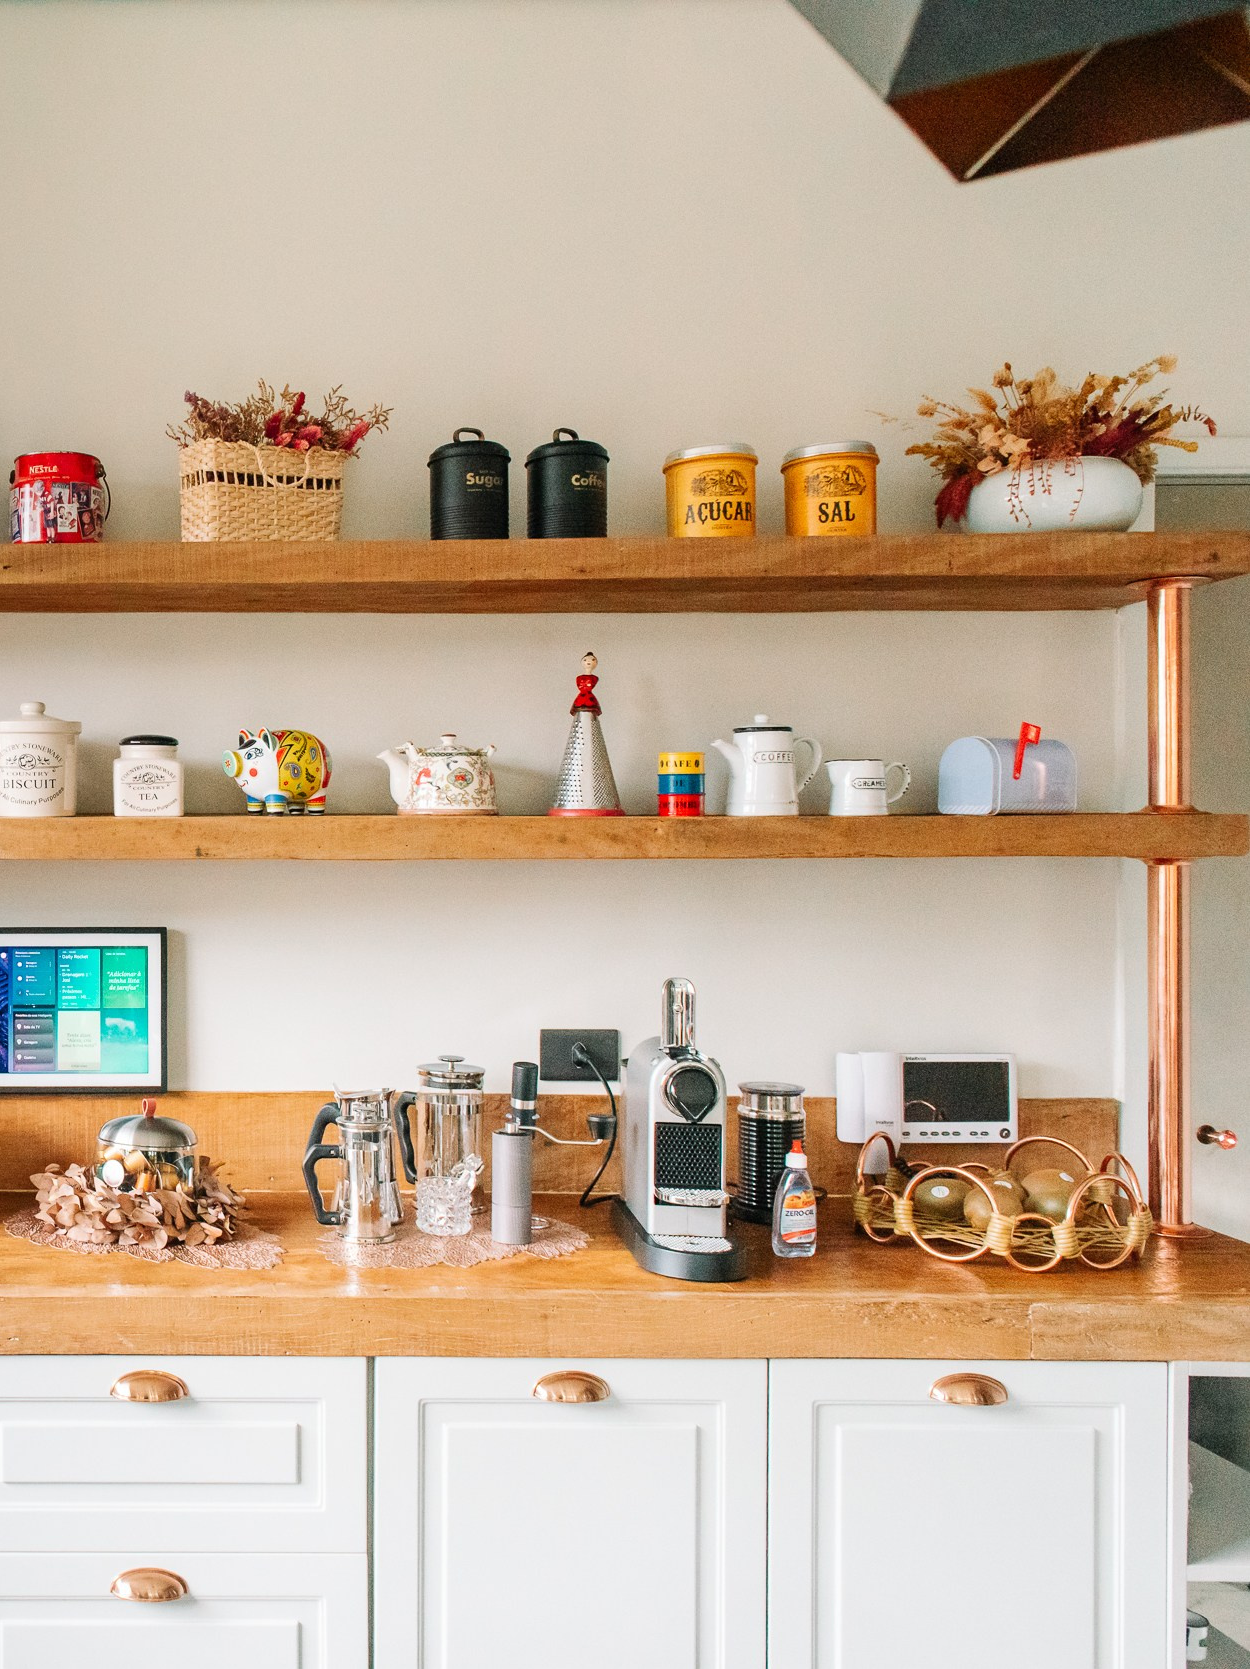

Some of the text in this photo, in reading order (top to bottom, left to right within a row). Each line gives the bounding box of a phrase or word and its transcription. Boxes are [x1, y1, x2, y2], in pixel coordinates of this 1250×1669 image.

[466, 472, 503, 488] Suga
[571, 473, 604, 487] Coffe
[684, 498, 753, 526] AÇÚCAR
[818, 500, 856, 523] SAL
[22, 743, 64, 763] STONEWARE
[121, 765, 144, 781] COUNTRY
[3, 778, 57, 789] BISCUIT
[10, 797, 38, 806] Culinary
[38, 786, 65, 804] Purposes
[139, 793, 159, 801] TEA
